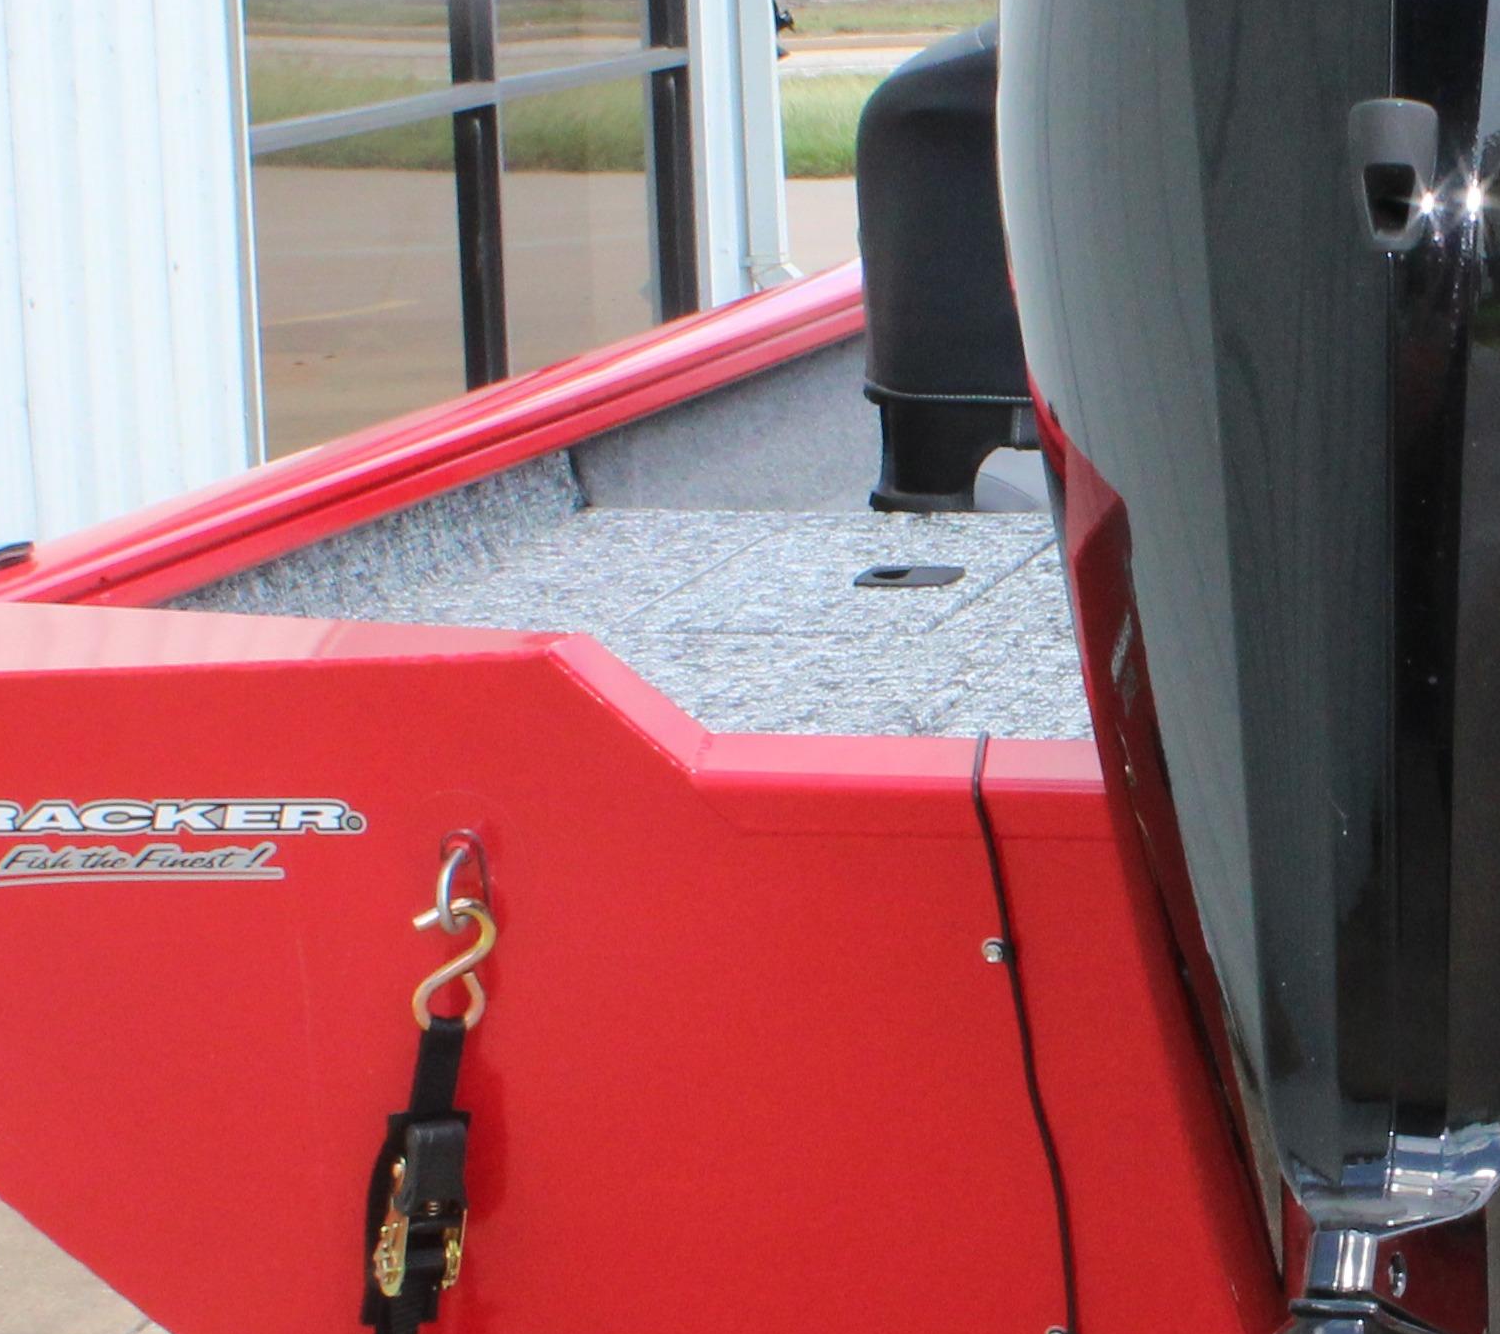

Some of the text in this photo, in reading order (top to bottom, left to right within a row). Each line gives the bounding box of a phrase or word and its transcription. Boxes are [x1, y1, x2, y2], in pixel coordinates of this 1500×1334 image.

[2, 848, 72, 871] Fish
[79, 848, 127, 869] the
[135, 848, 239, 869] Finest
